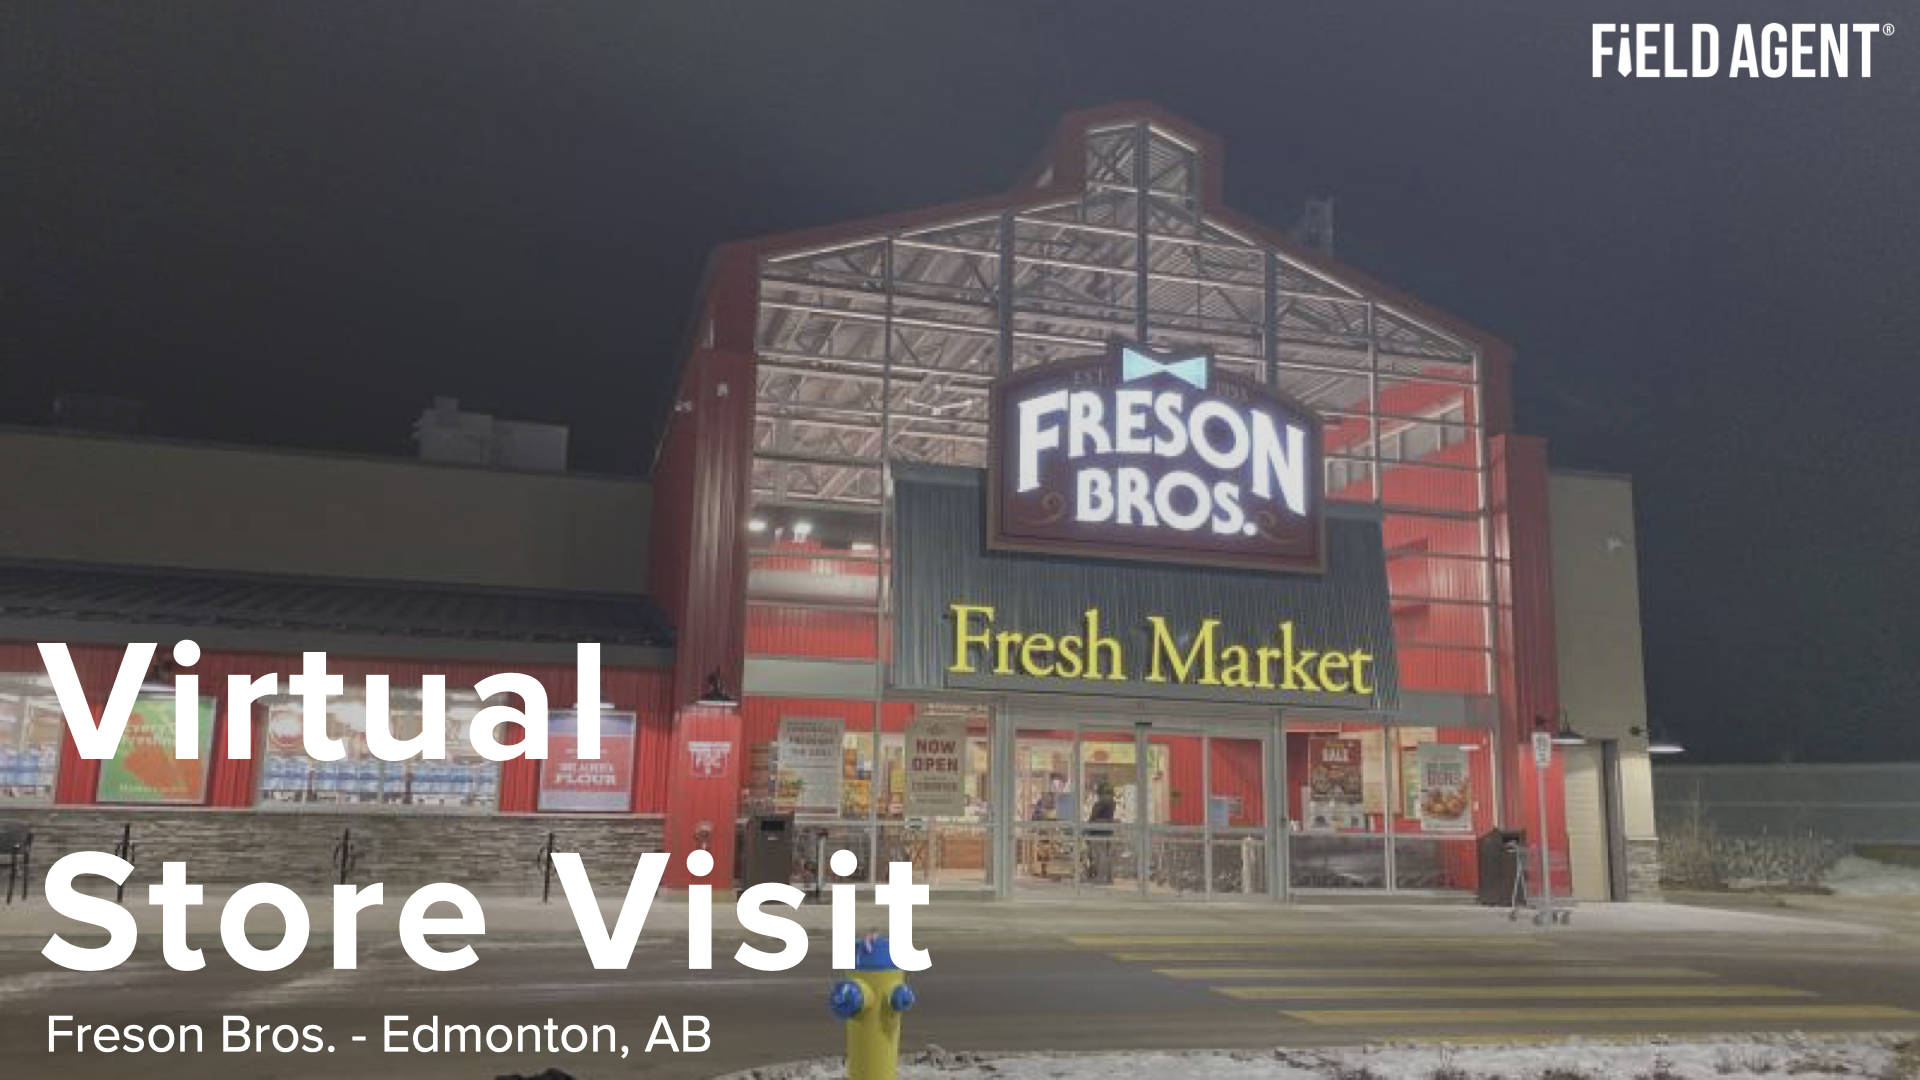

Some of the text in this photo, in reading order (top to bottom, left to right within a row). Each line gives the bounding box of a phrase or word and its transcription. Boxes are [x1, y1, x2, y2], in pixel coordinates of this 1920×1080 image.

[1017, 388, 1306, 516] FRESON
[1075, 467, 1258, 536] BROS.
[947, 602, 1374, 695] Fresh Market
[911, 757, 958, 773] OPEN
[916, 738, 955, 754] NOW
